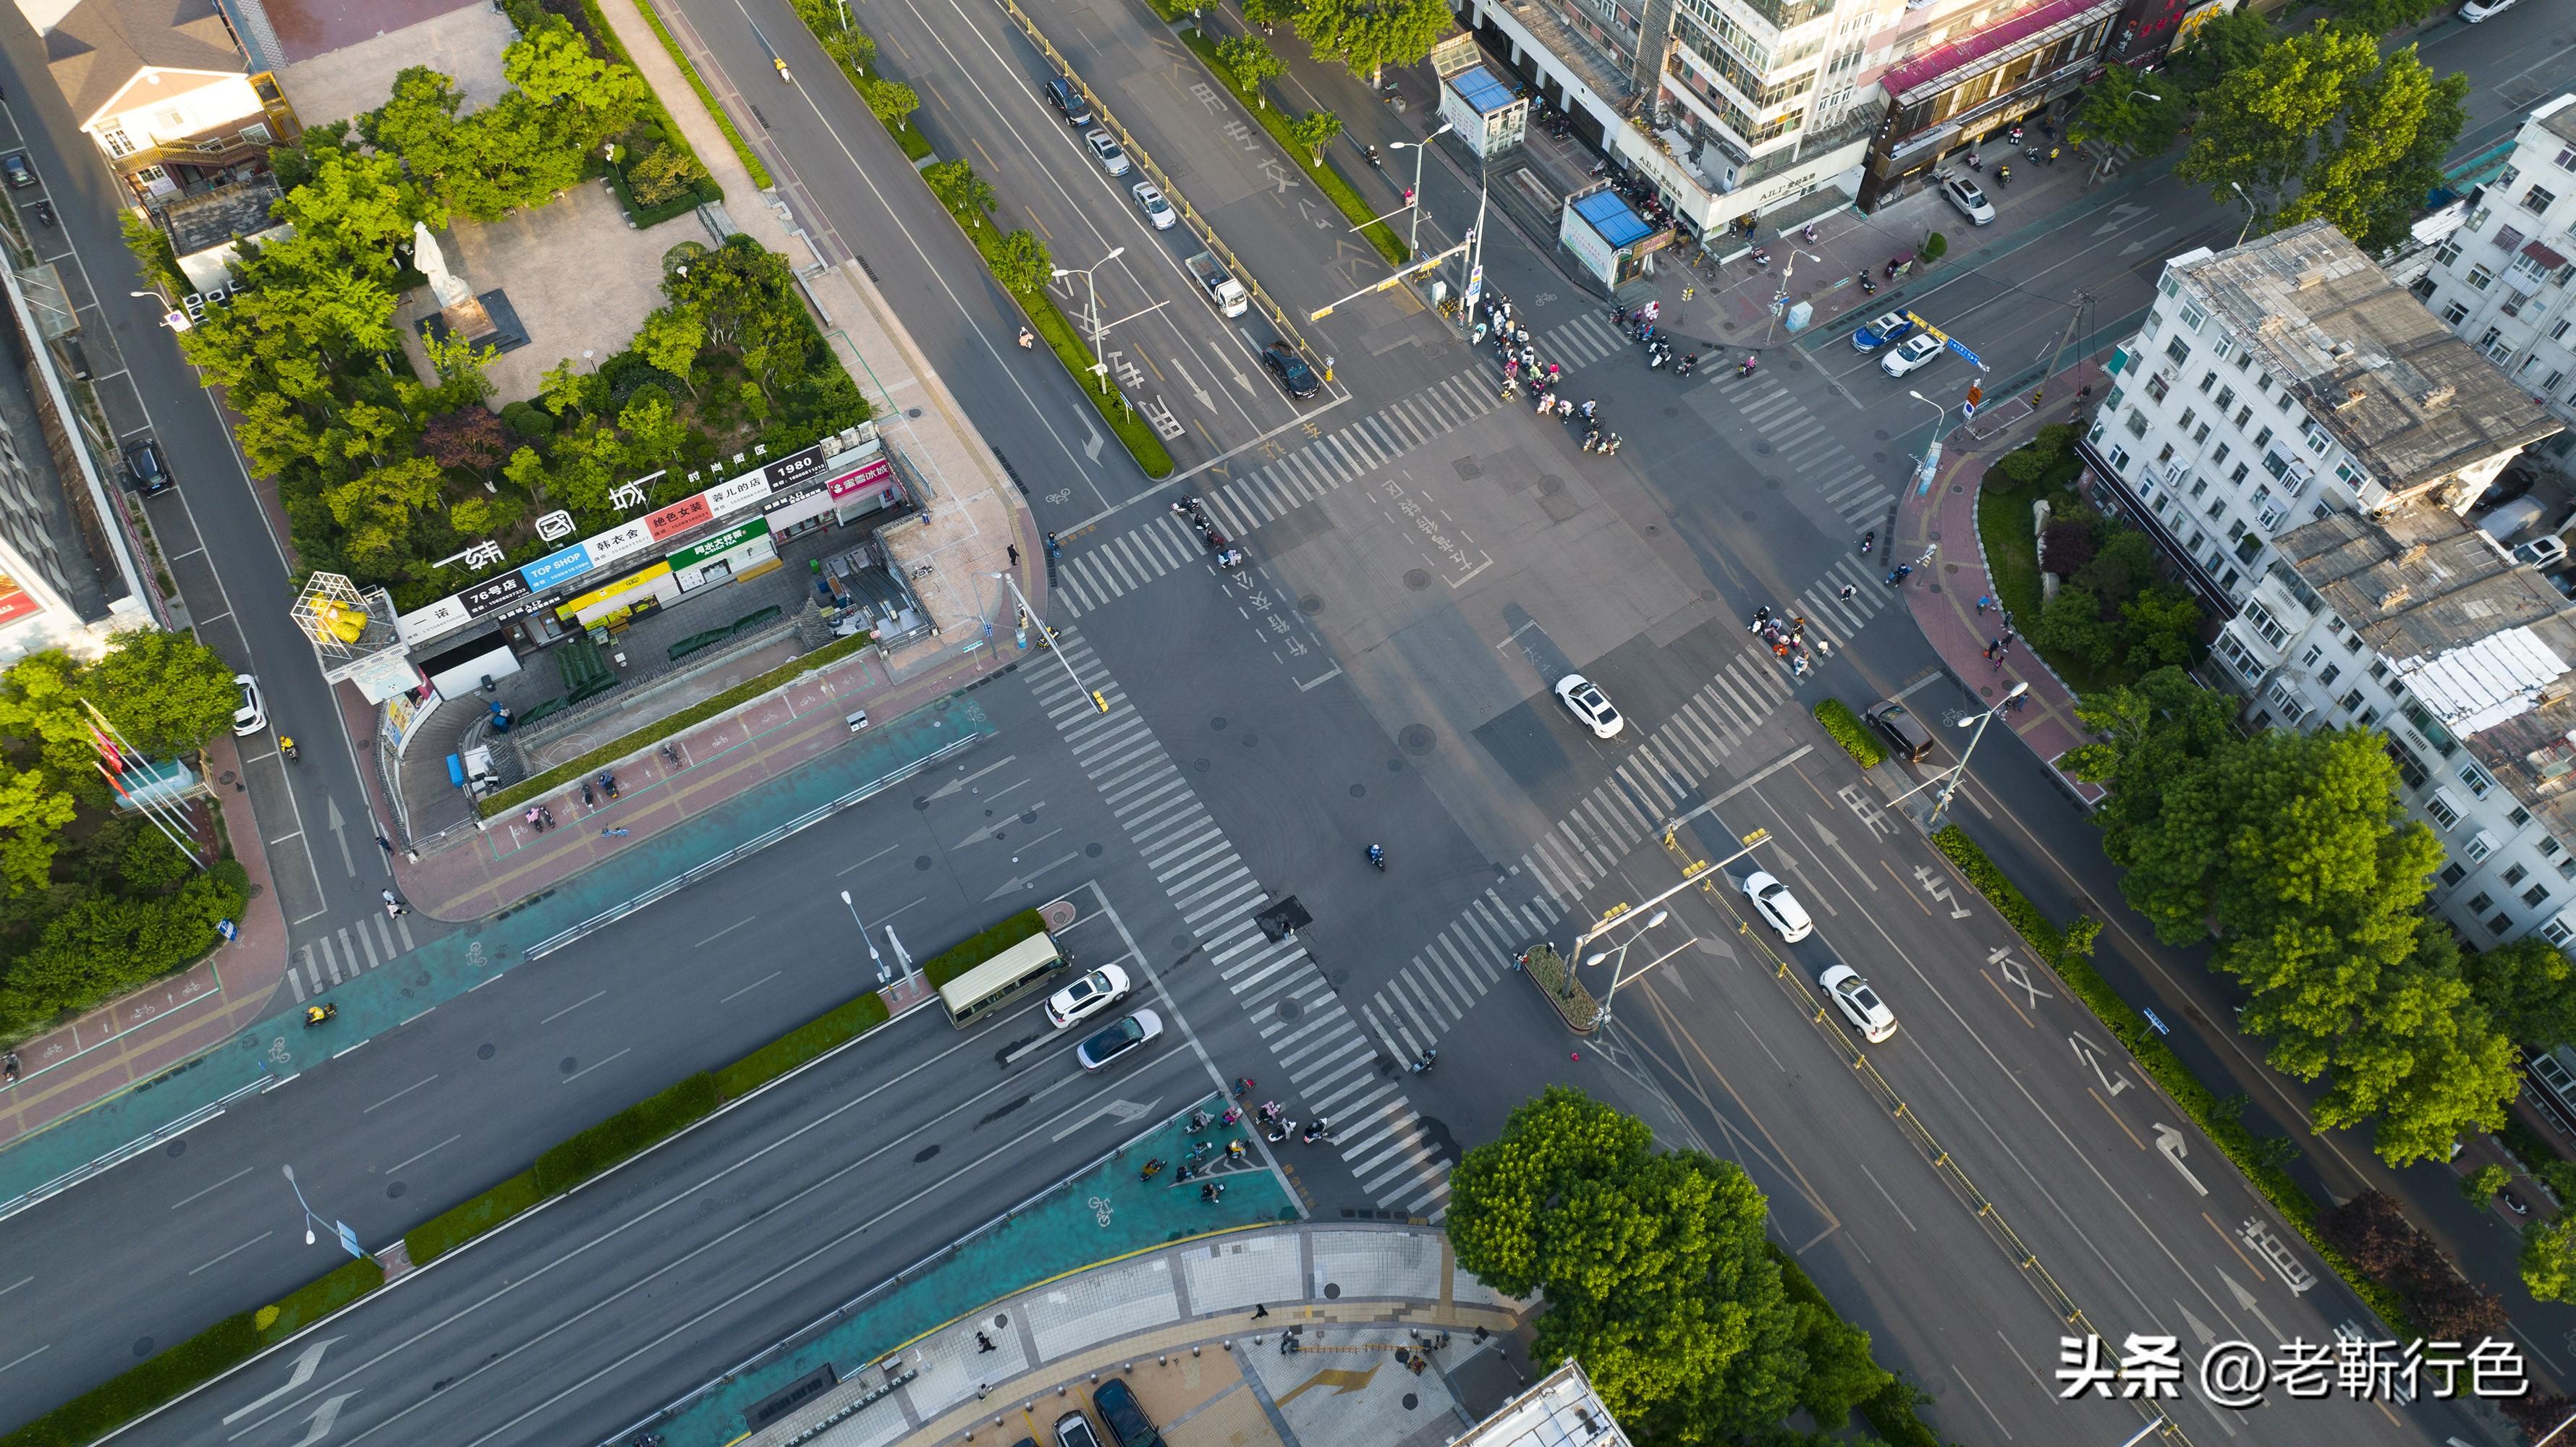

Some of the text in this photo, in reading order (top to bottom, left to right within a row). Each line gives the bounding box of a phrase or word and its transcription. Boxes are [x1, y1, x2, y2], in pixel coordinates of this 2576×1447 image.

[687, 444, 767, 483] 时尚街区
[777, 457, 812, 477] 1980
[712, 478, 760, 502] 蓉儿的店
[653, 501, 703, 528] 绝色女装
[596, 529, 638, 551] 韩衣舍
[530, 552, 581, 579] TOP SHOP
[470, 579, 517, 604] 76号店
